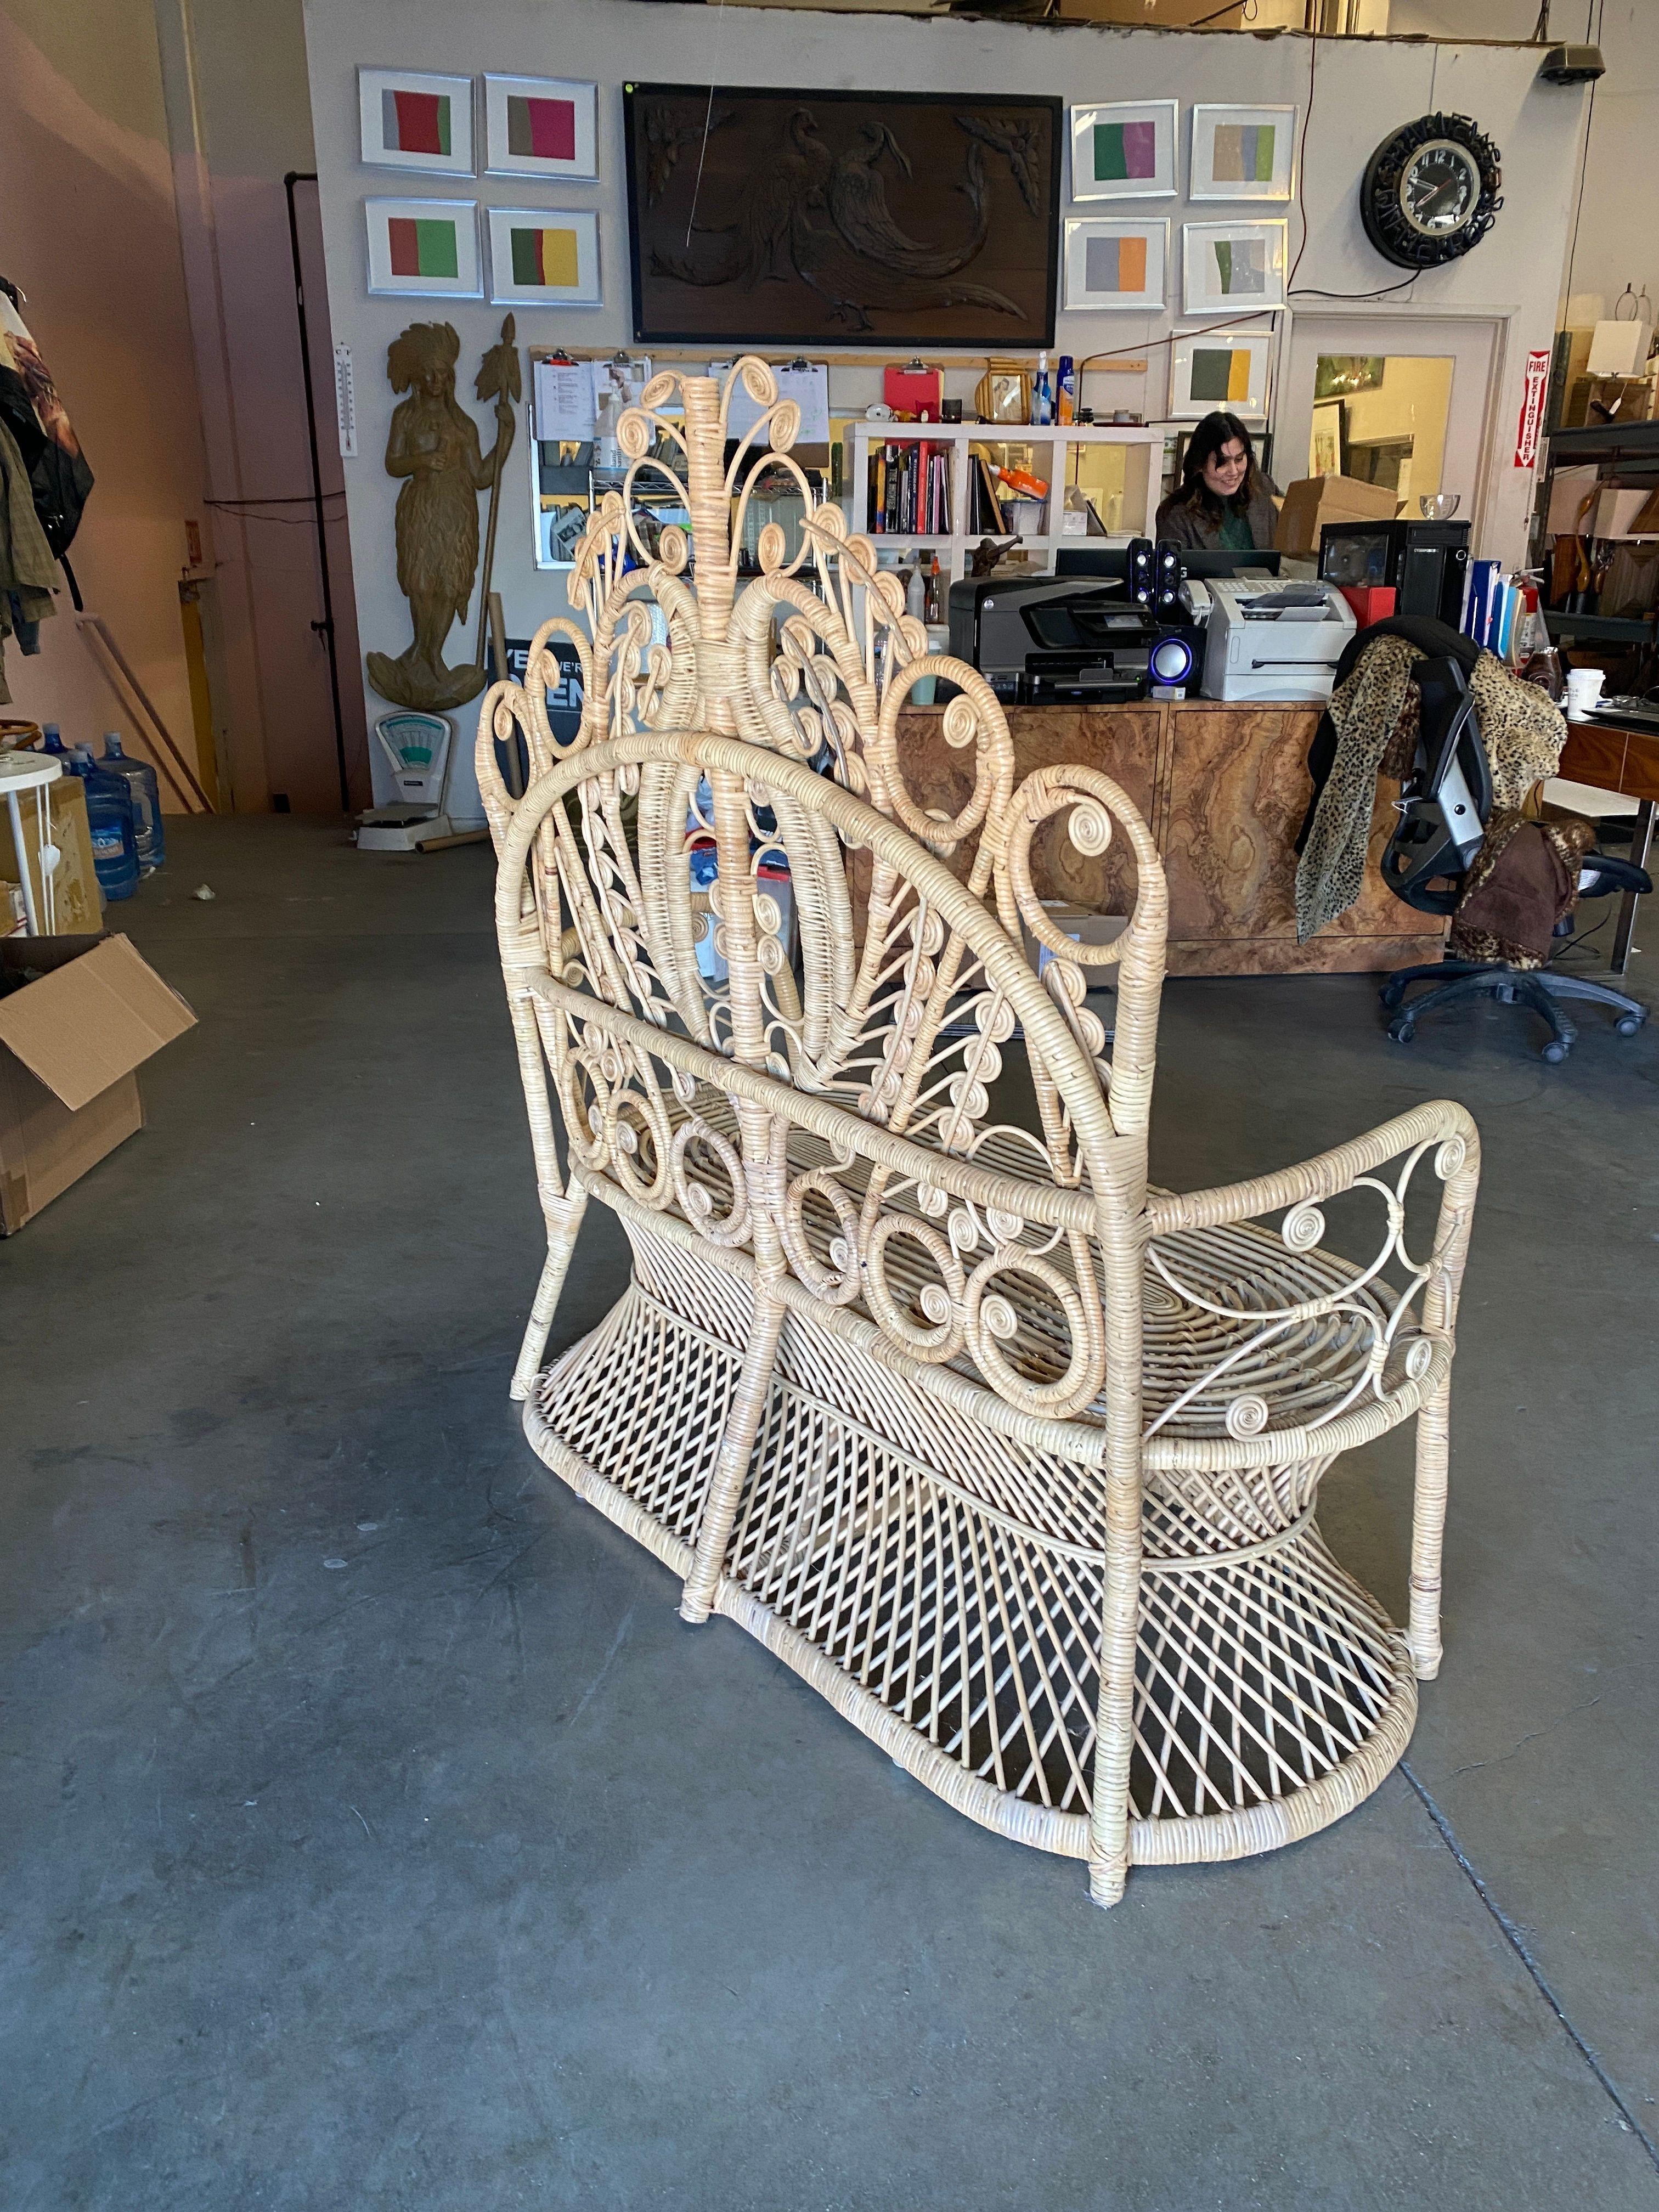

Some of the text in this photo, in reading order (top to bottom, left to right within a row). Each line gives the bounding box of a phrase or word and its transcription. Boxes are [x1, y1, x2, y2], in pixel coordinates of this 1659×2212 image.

[1435, 149, 1446, 163] 12
[1459, 167, 1467, 180] 2
[1528, 361, 1546, 372] FIRE
[1523, 376, 1539, 460] EXTINGUISHER
